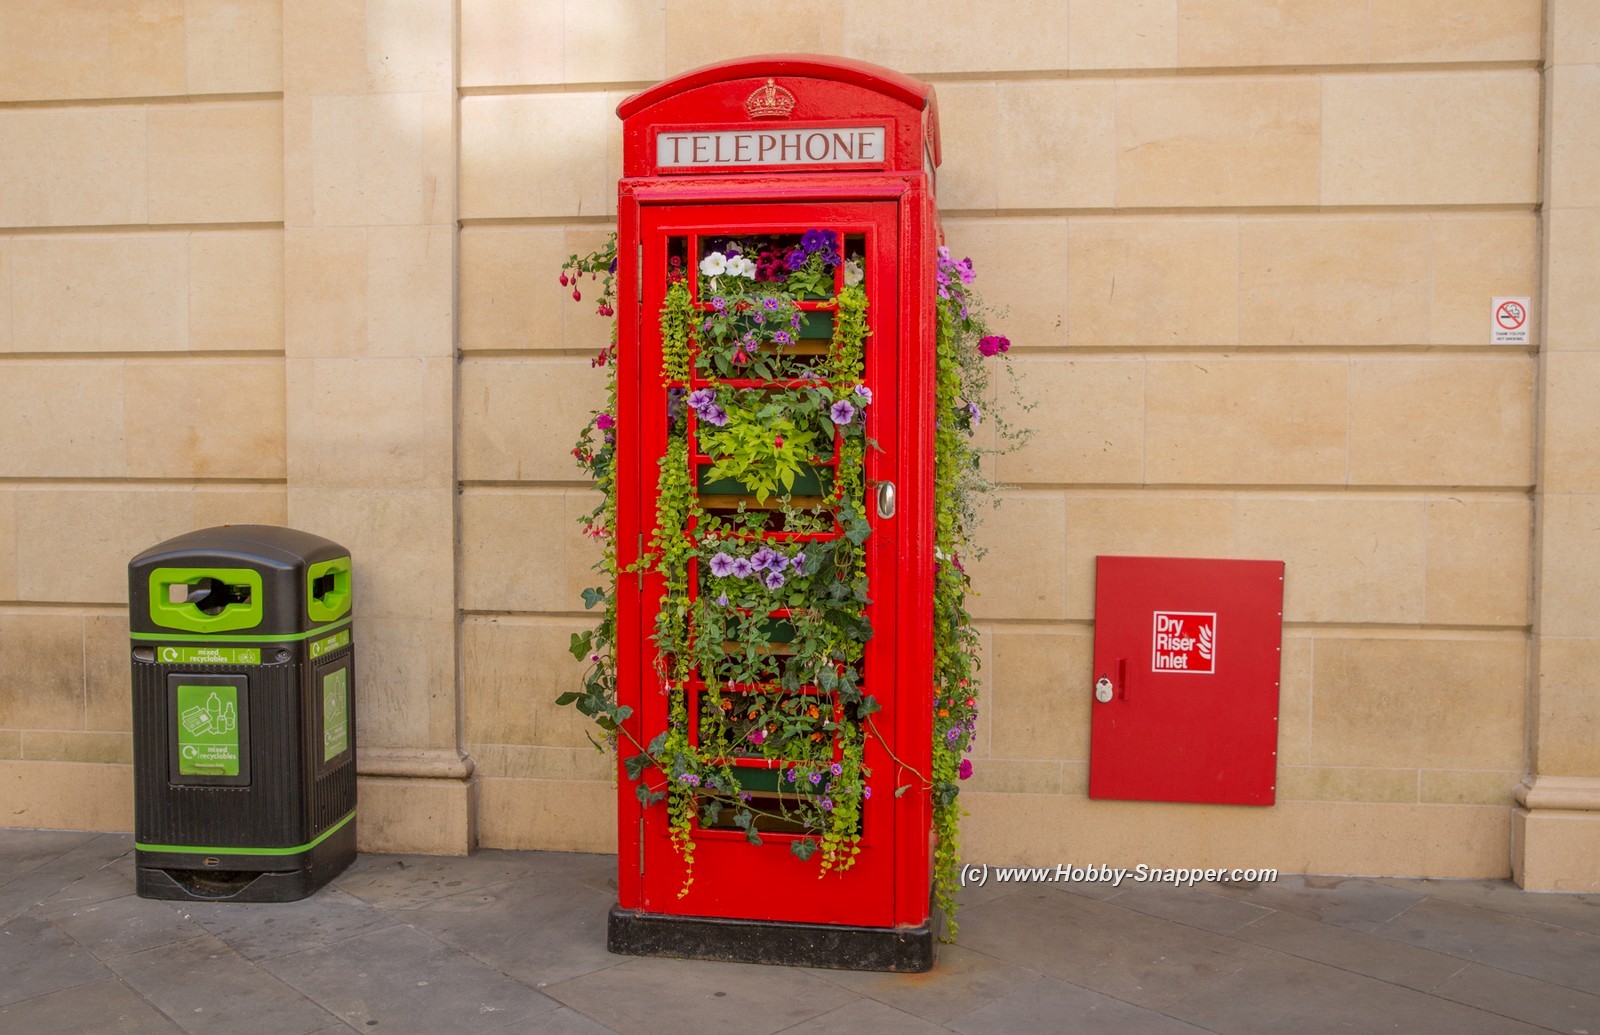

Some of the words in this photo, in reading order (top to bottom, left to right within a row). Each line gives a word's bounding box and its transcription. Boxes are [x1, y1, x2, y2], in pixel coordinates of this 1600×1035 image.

[666, 132, 876, 163] TELEPHONE
[1157, 615, 1184, 637] Dry
[1156, 633, 1196, 651] Riser
[198, 648, 219, 656] mixed
[190, 655, 228, 663] recyclables
[1156, 651, 1188, 669] Inlet
[207, 745, 228, 753] mixed
[200, 752, 236, 761] recyclables
